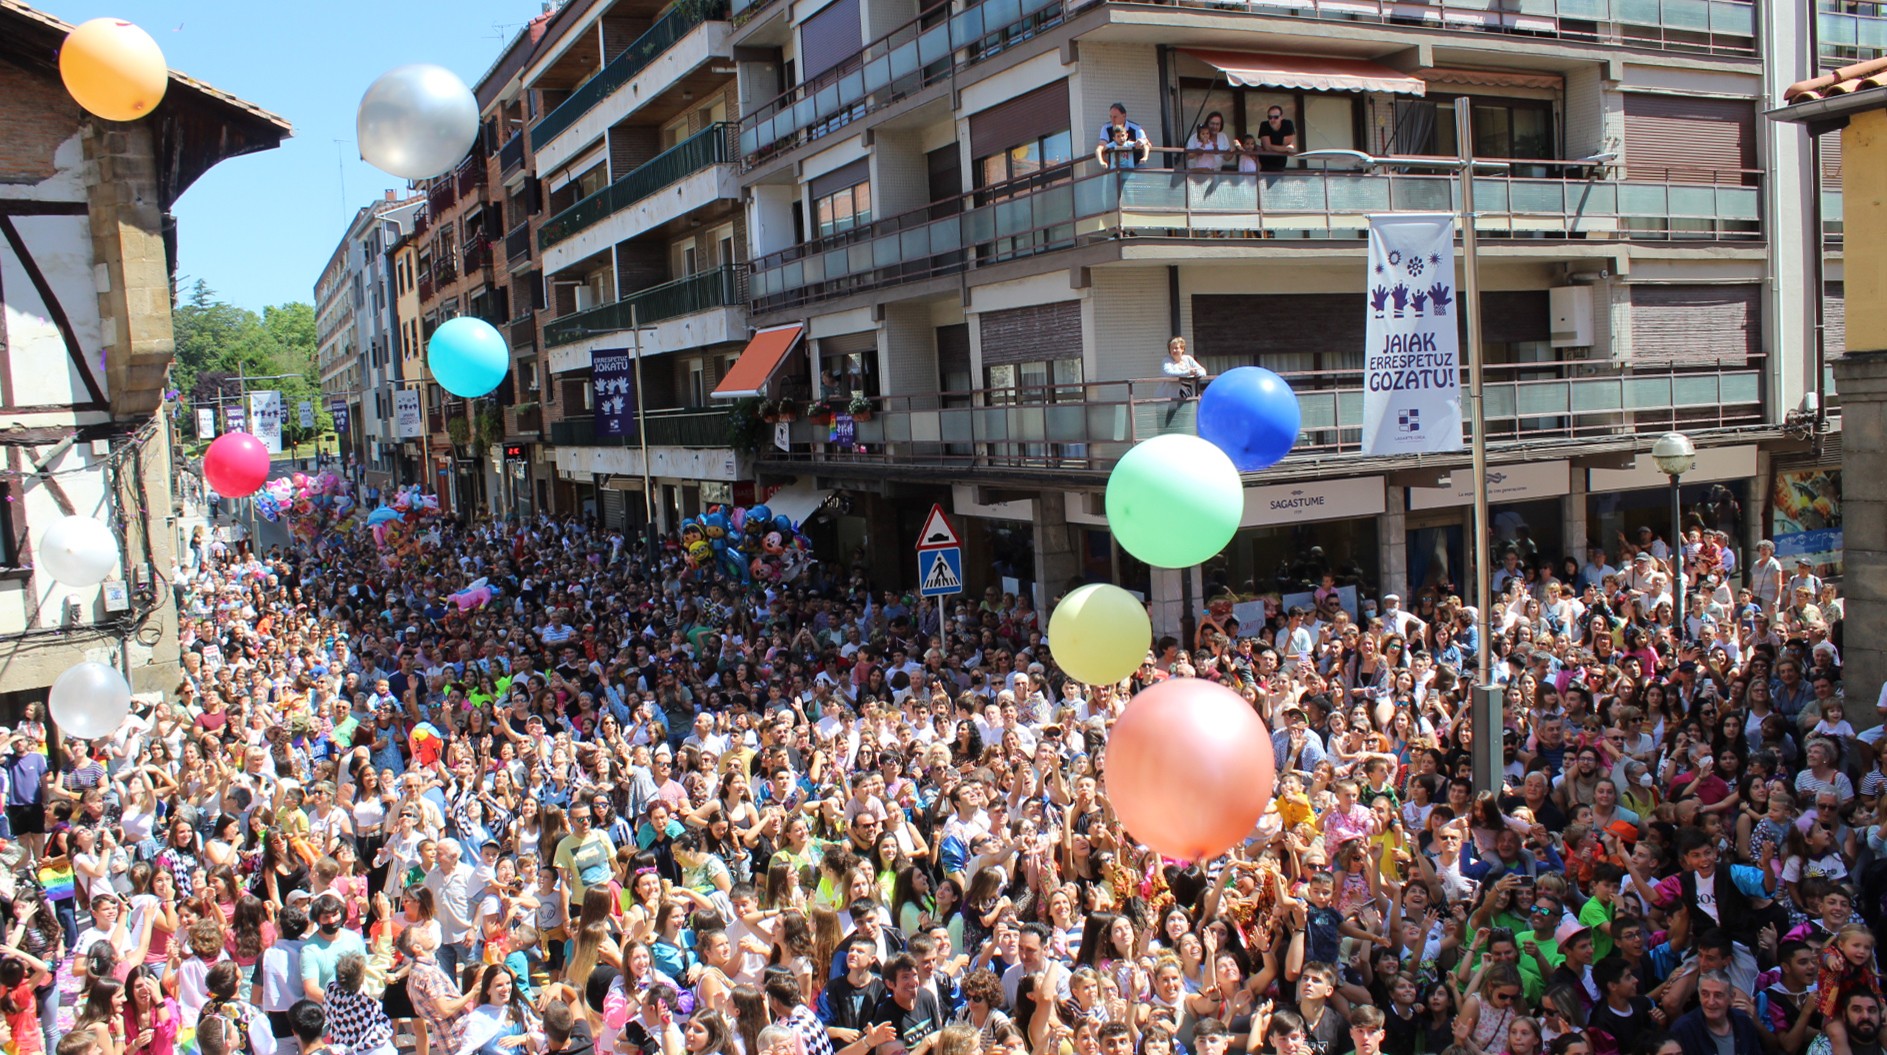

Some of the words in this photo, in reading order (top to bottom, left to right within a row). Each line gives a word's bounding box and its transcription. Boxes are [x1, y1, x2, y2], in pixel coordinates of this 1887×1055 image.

[1382, 332, 1437, 354] JAIAK
[594, 361, 629, 373] JOKATU
[1369, 353, 1453, 370] ERRESPETUZ
[1369, 368, 1455, 392] GOZATU!
[1270, 496, 1325, 510] SAGASTUME
